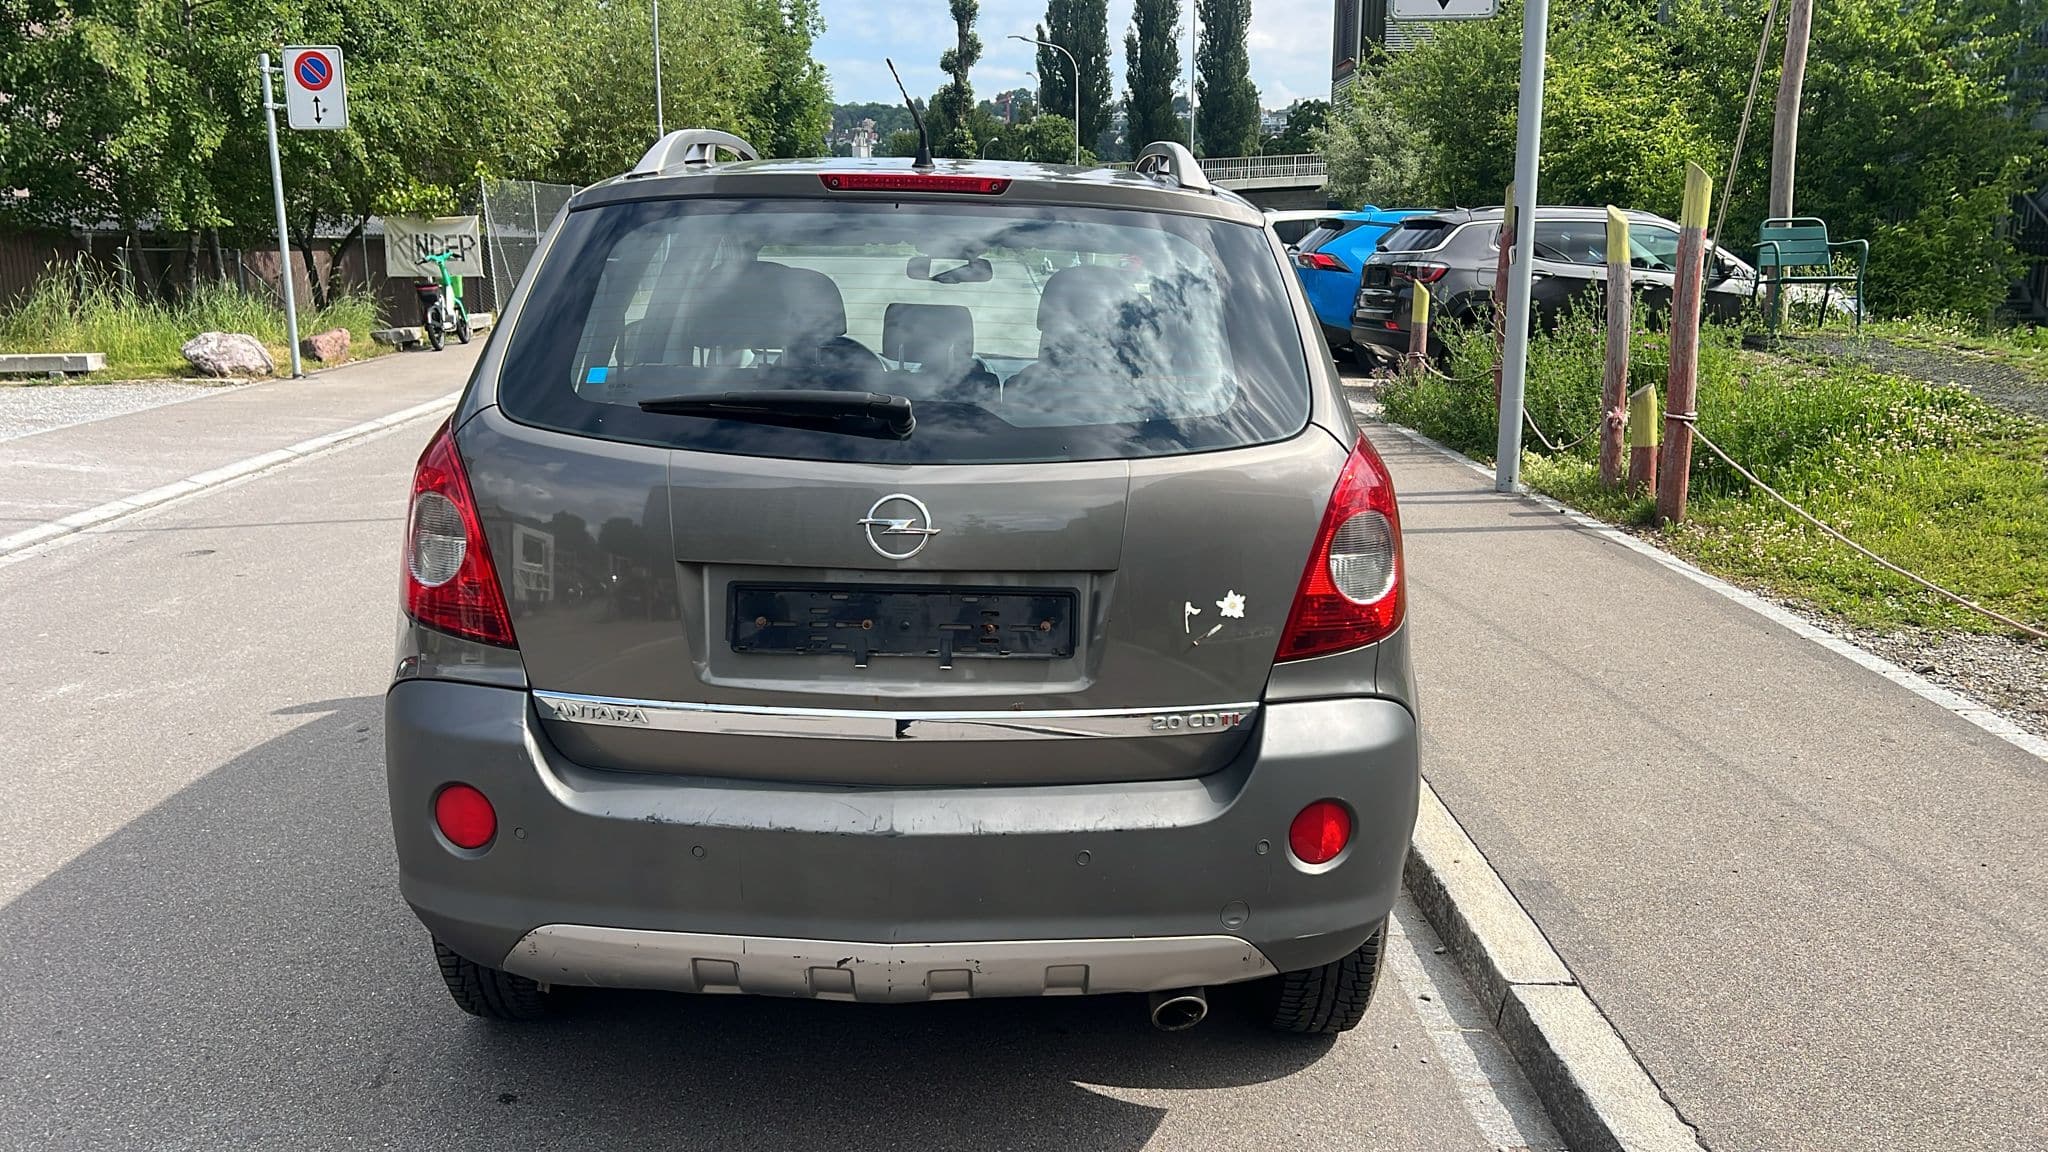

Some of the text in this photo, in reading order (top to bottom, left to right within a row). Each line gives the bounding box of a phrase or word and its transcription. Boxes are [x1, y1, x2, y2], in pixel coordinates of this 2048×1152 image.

[389, 232, 477, 262] KINDER
[554, 702, 648, 723] ANTARA
[1187, 712, 1240, 728] CDTI
